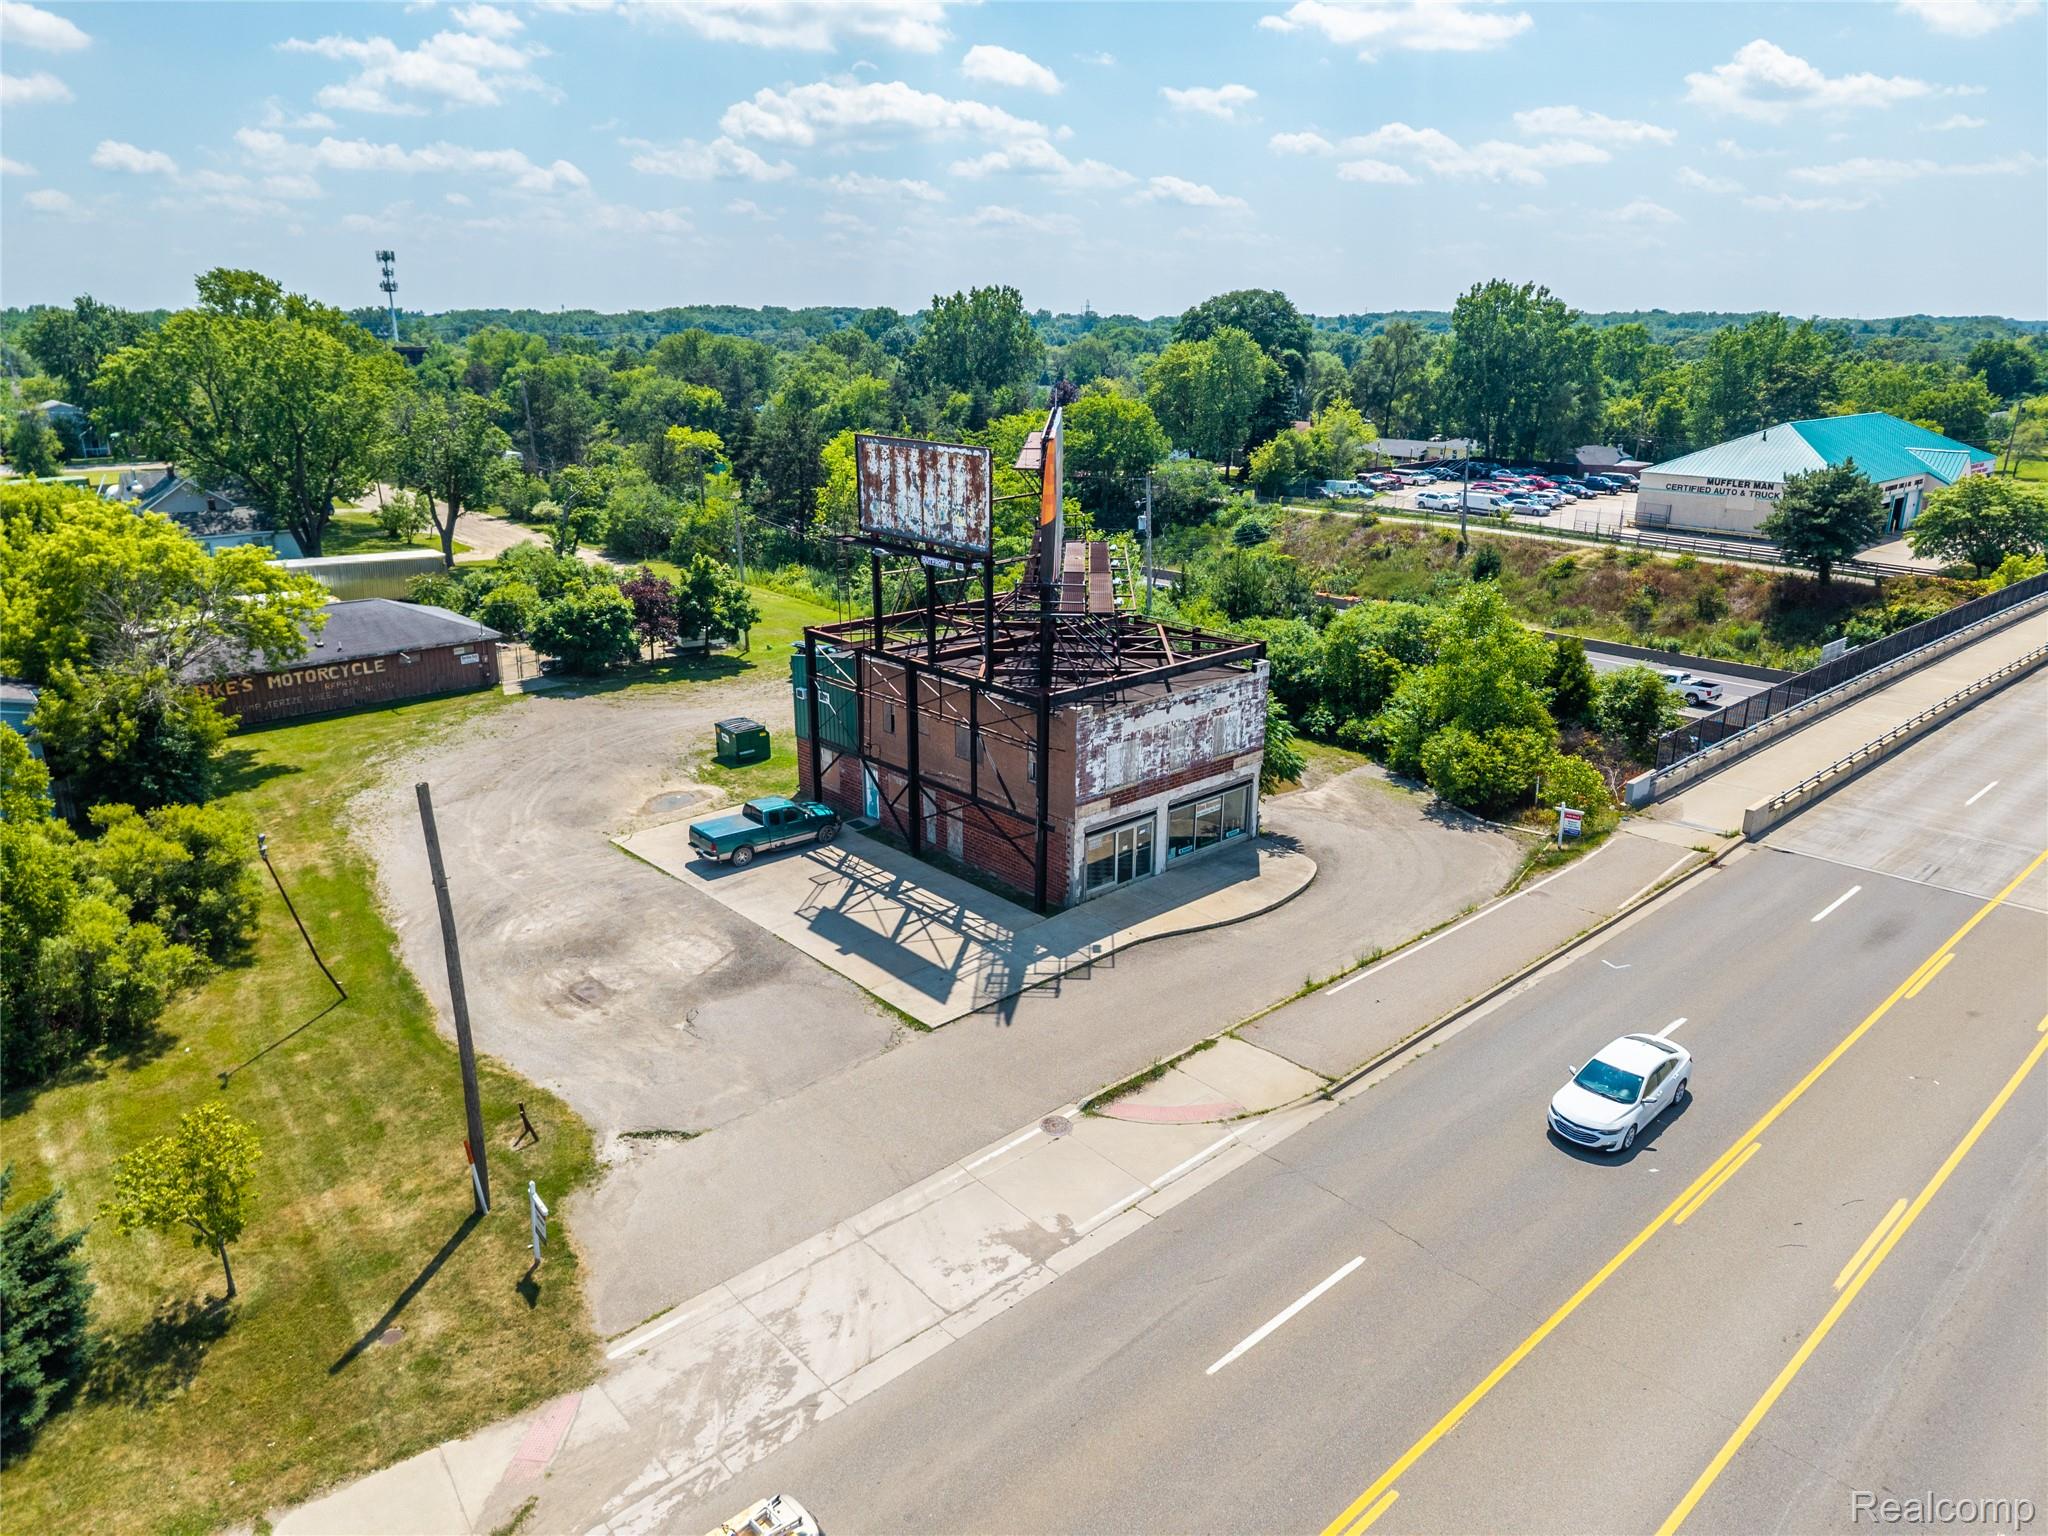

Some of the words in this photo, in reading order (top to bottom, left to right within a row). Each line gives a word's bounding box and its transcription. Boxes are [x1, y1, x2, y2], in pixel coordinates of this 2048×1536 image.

[1665, 483, 1712, 494] CERTIFIED
[1713, 487, 1738, 496] AUTO
[1739, 488, 1746, 497] &
[1750, 490, 1781, 500] TRUCK
[1706, 477, 1751, 489] MUFFLER
[1753, 481, 1775, 490] MAN
[266, 659, 386, 690] MOTORCYCLE
